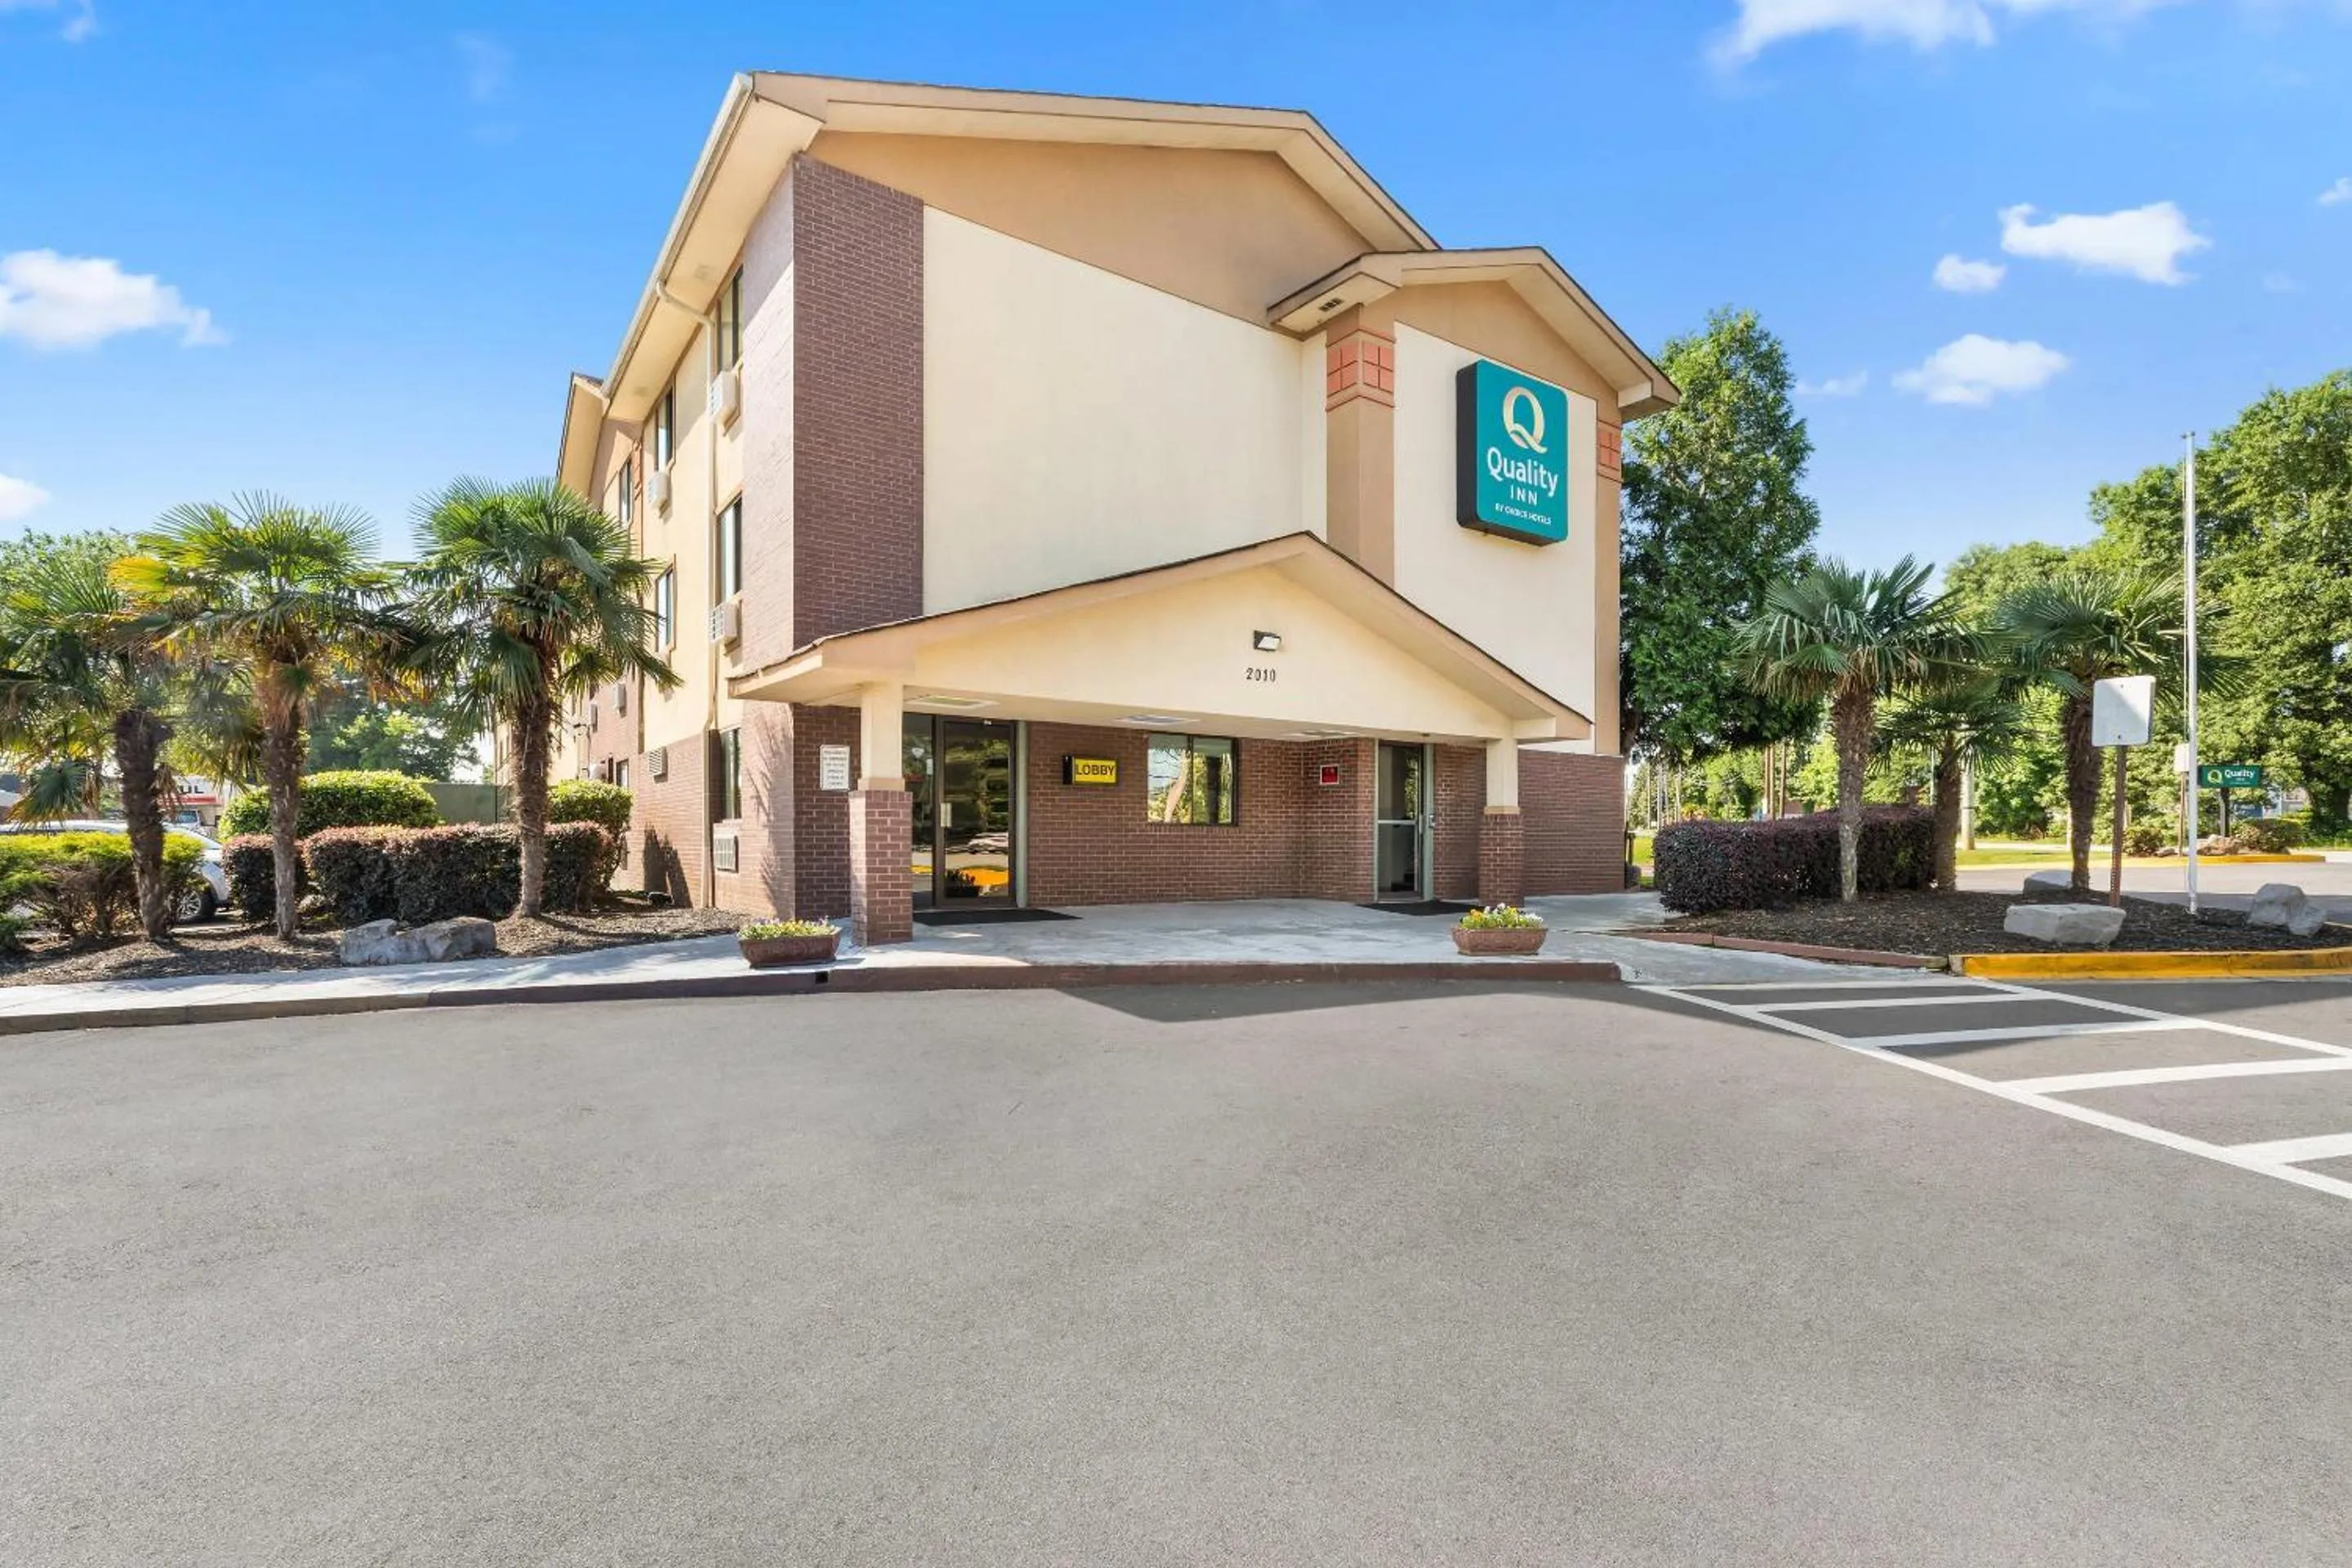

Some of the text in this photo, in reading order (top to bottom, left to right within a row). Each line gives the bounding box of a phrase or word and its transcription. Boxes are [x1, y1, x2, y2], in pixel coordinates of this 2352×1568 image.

[1503, 385, 1548, 454] Q
[1487, 446, 1558, 498] Quality
[1510, 483, 1538, 506] INN
[1245, 667, 1276, 682] 2010
[1076, 764, 1115, 777] LOBBY
[2224, 769, 2255, 778] Quality
